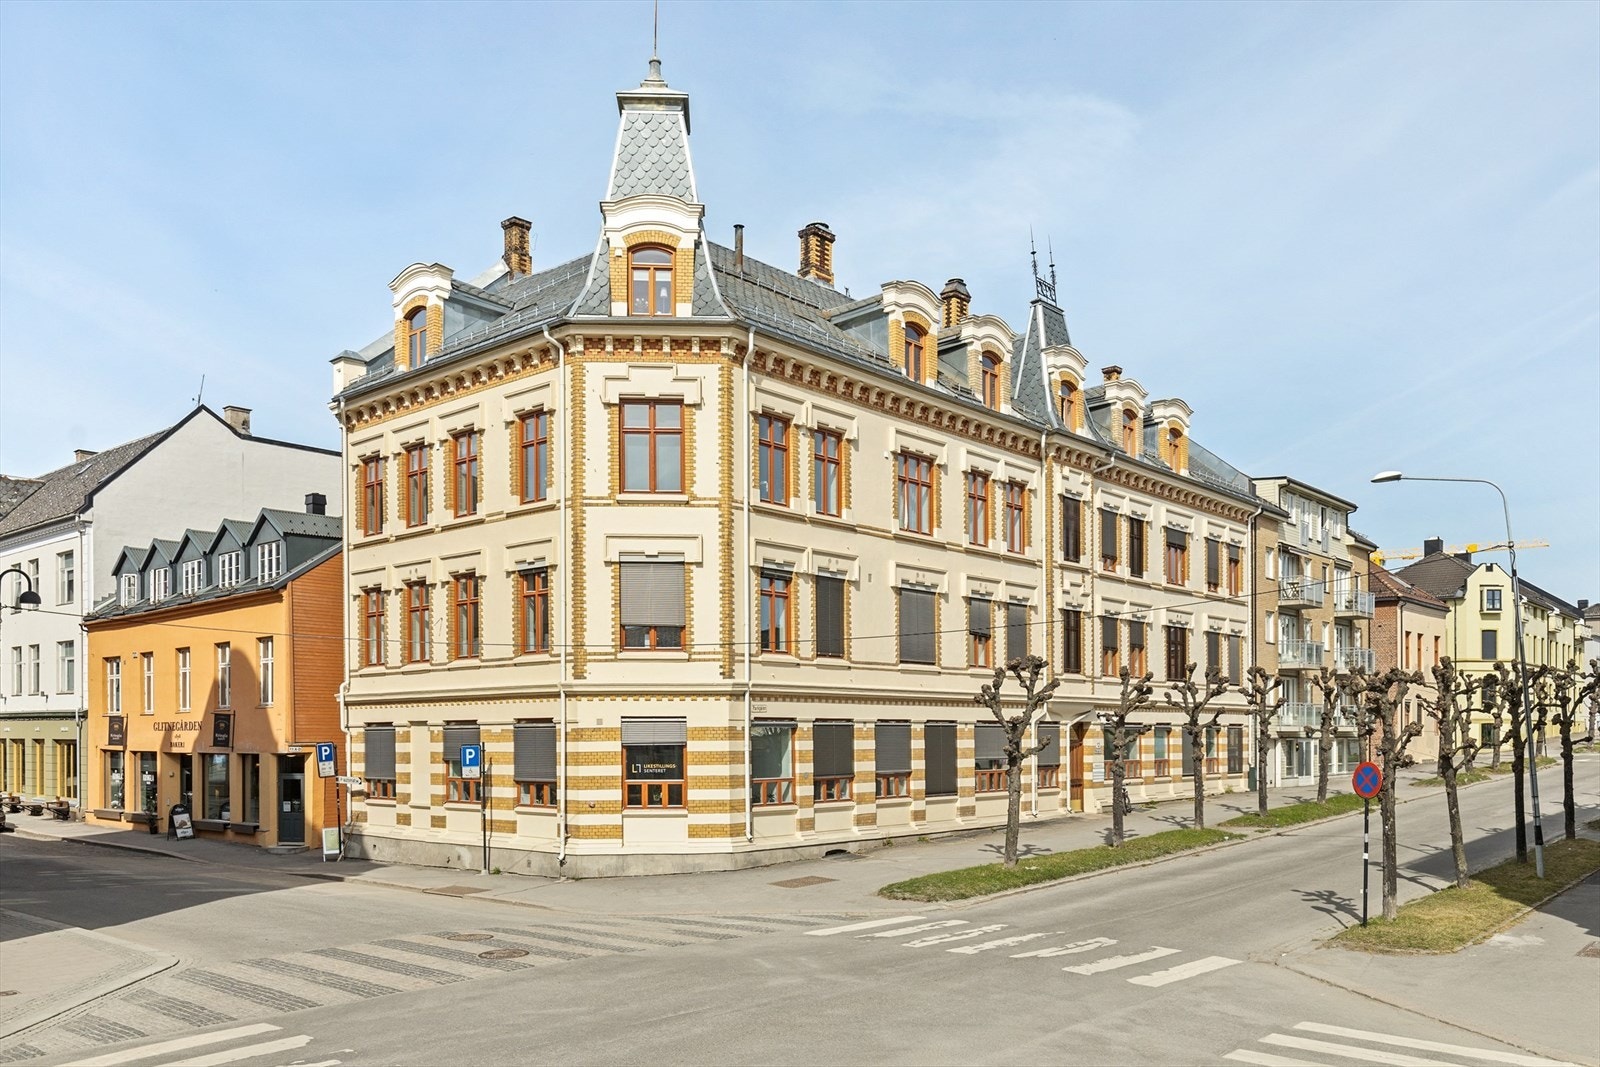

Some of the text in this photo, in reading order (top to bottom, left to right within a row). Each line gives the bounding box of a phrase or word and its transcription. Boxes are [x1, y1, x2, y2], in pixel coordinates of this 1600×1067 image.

[153, 719, 203, 732] GLITNEGÅRDEN
[321, 746, 330, 760] P
[465, 748, 476, 764] P
